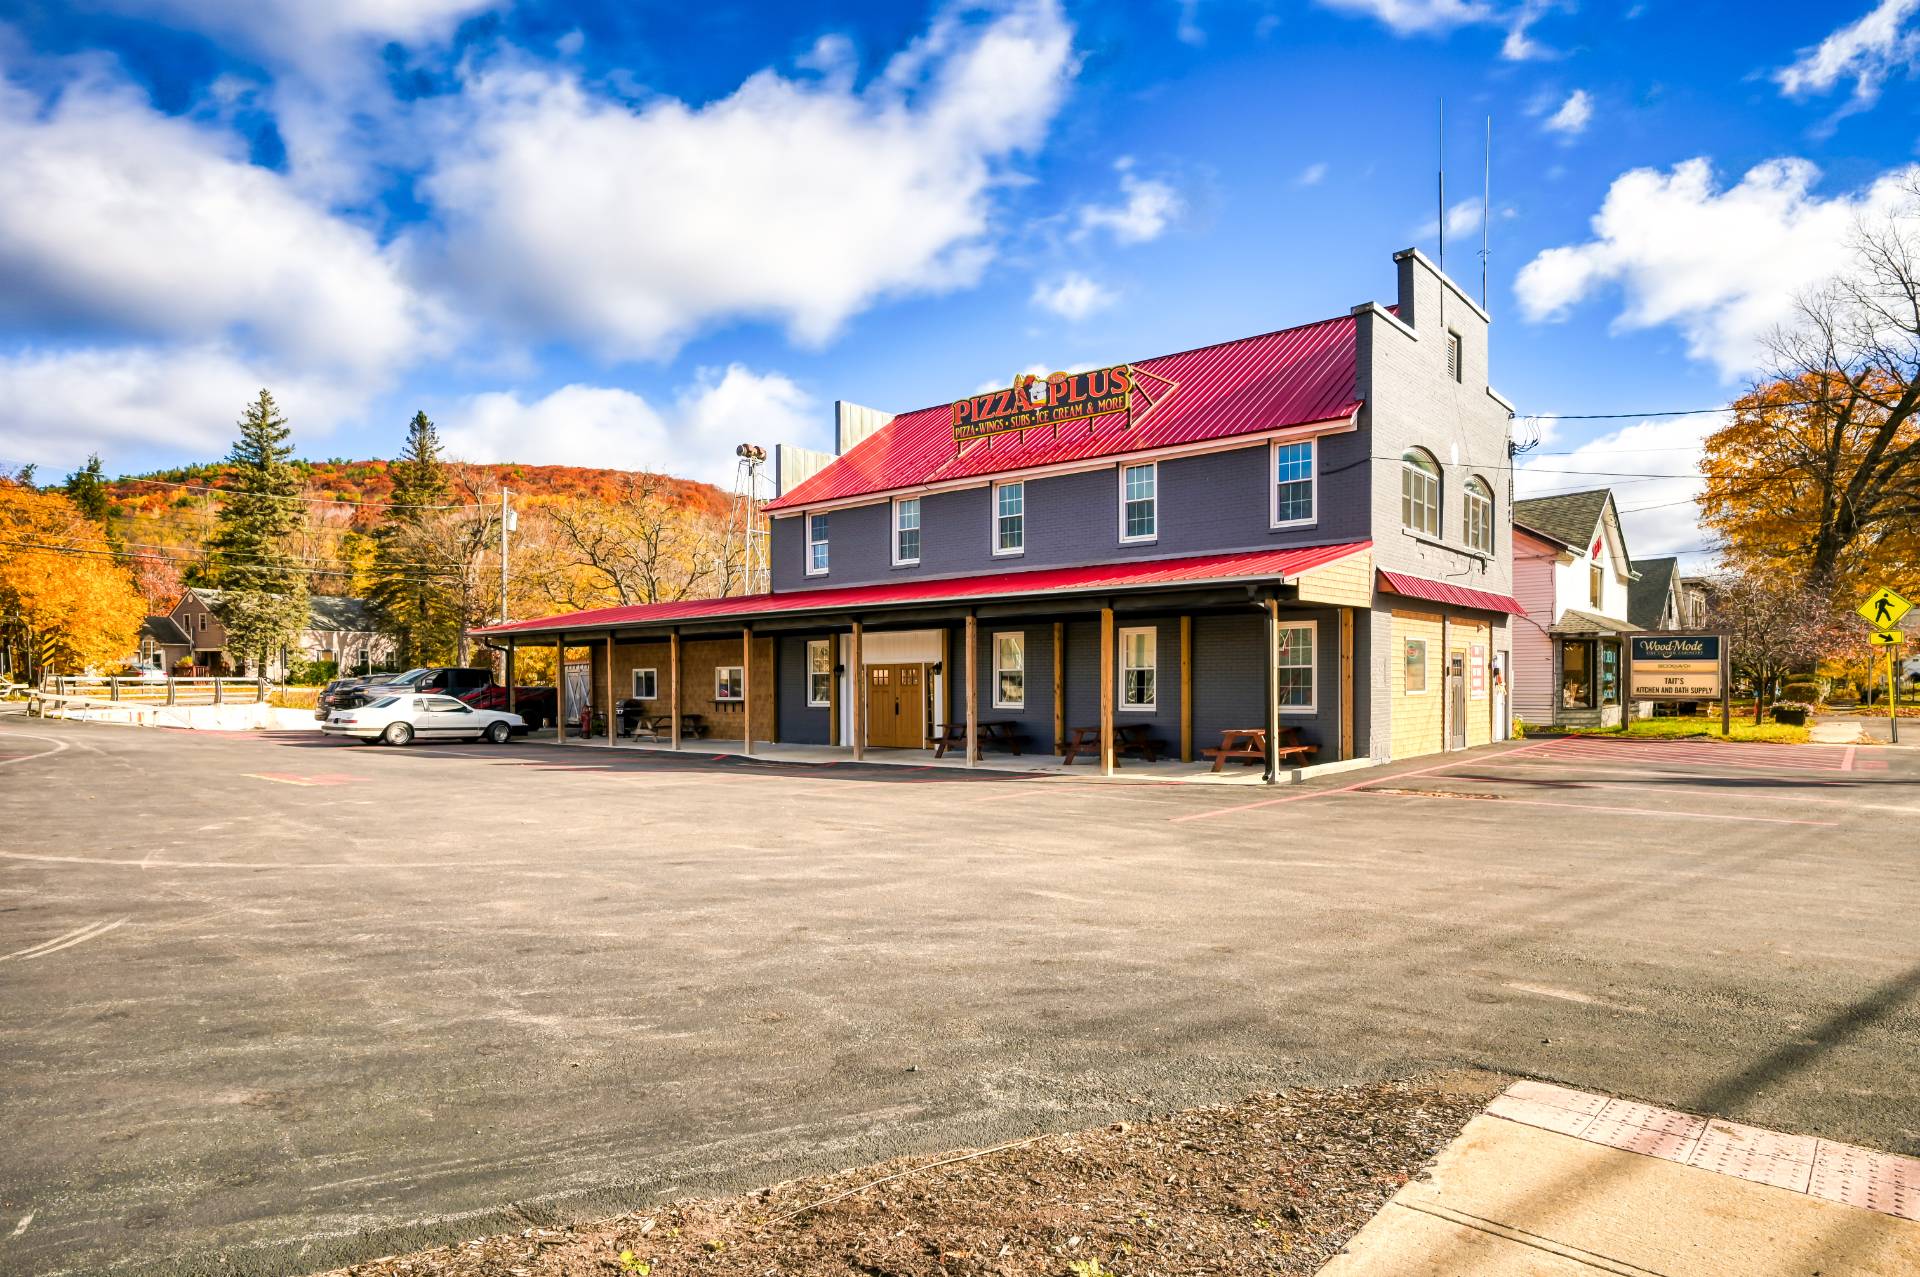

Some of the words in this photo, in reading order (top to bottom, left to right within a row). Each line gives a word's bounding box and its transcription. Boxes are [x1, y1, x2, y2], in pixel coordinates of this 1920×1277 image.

[953, 388, 1033, 425] PIZZA
[1048, 365, 1129, 406] PLUS
[955, 424, 976, 438] PIZZA
[979, 420, 1004, 433] WINGS
[1010, 414, 1031, 427] SUBS
[1036, 409, 1050, 423] ICE
[1053, 404, 1083, 420] CREAM
[1086, 402, 1094, 414] &
[1098, 396, 1124, 411] MORE
[1690, 687, 1713, 695] SUPPLY
